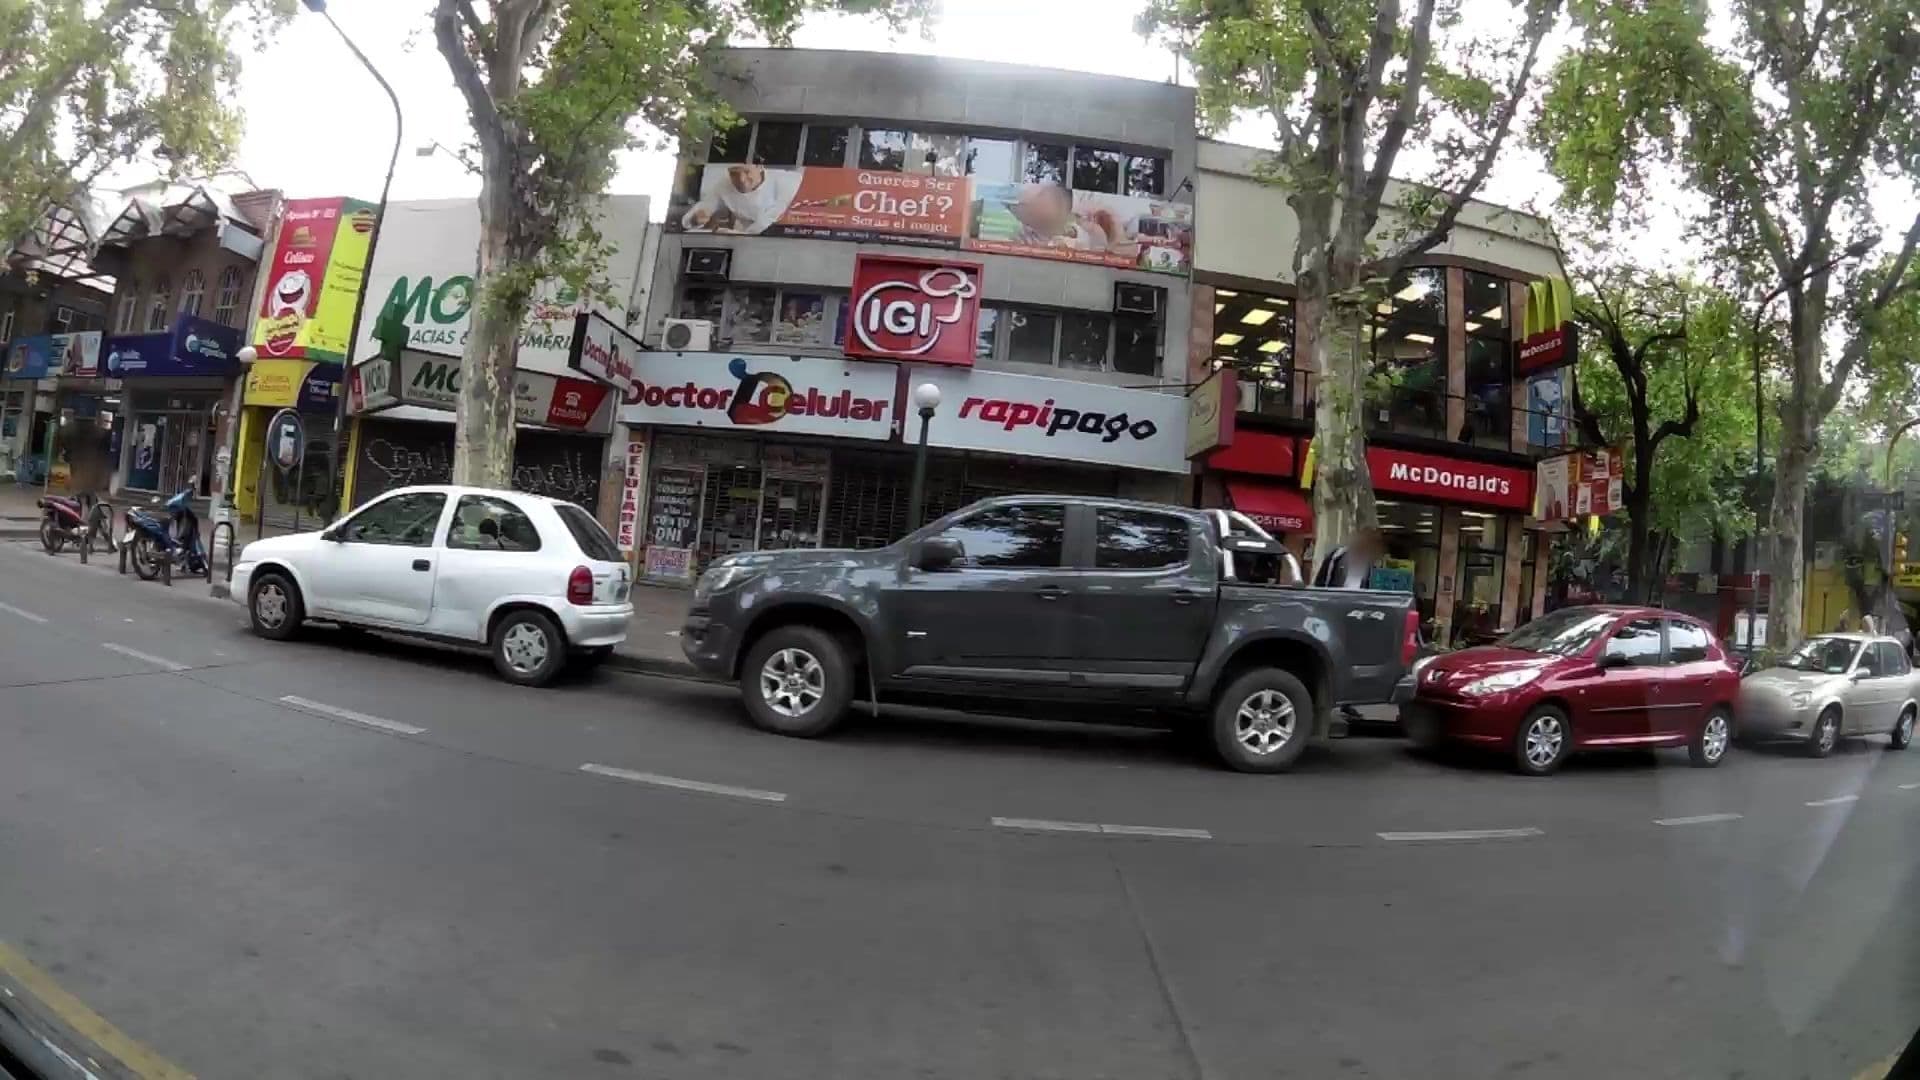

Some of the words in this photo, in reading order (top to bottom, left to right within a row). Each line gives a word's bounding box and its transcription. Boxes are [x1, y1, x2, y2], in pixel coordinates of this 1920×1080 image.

[925, 177, 956, 191] Ser
[854, 190, 953, 219] Chef?
[893, 218, 905, 229] el
[869, 299, 931, 337] IGI
[1520, 338, 1562, 359] McDonald's
[621, 379, 733, 409] Doctor
[759, 383, 888, 421] Celular
[958, 398, 1158, 443] rapipago
[1390, 462, 1511, 494] McDonald's
[620, 443, 642, 545] CELULARES
[655, 527, 681, 541] DNI
